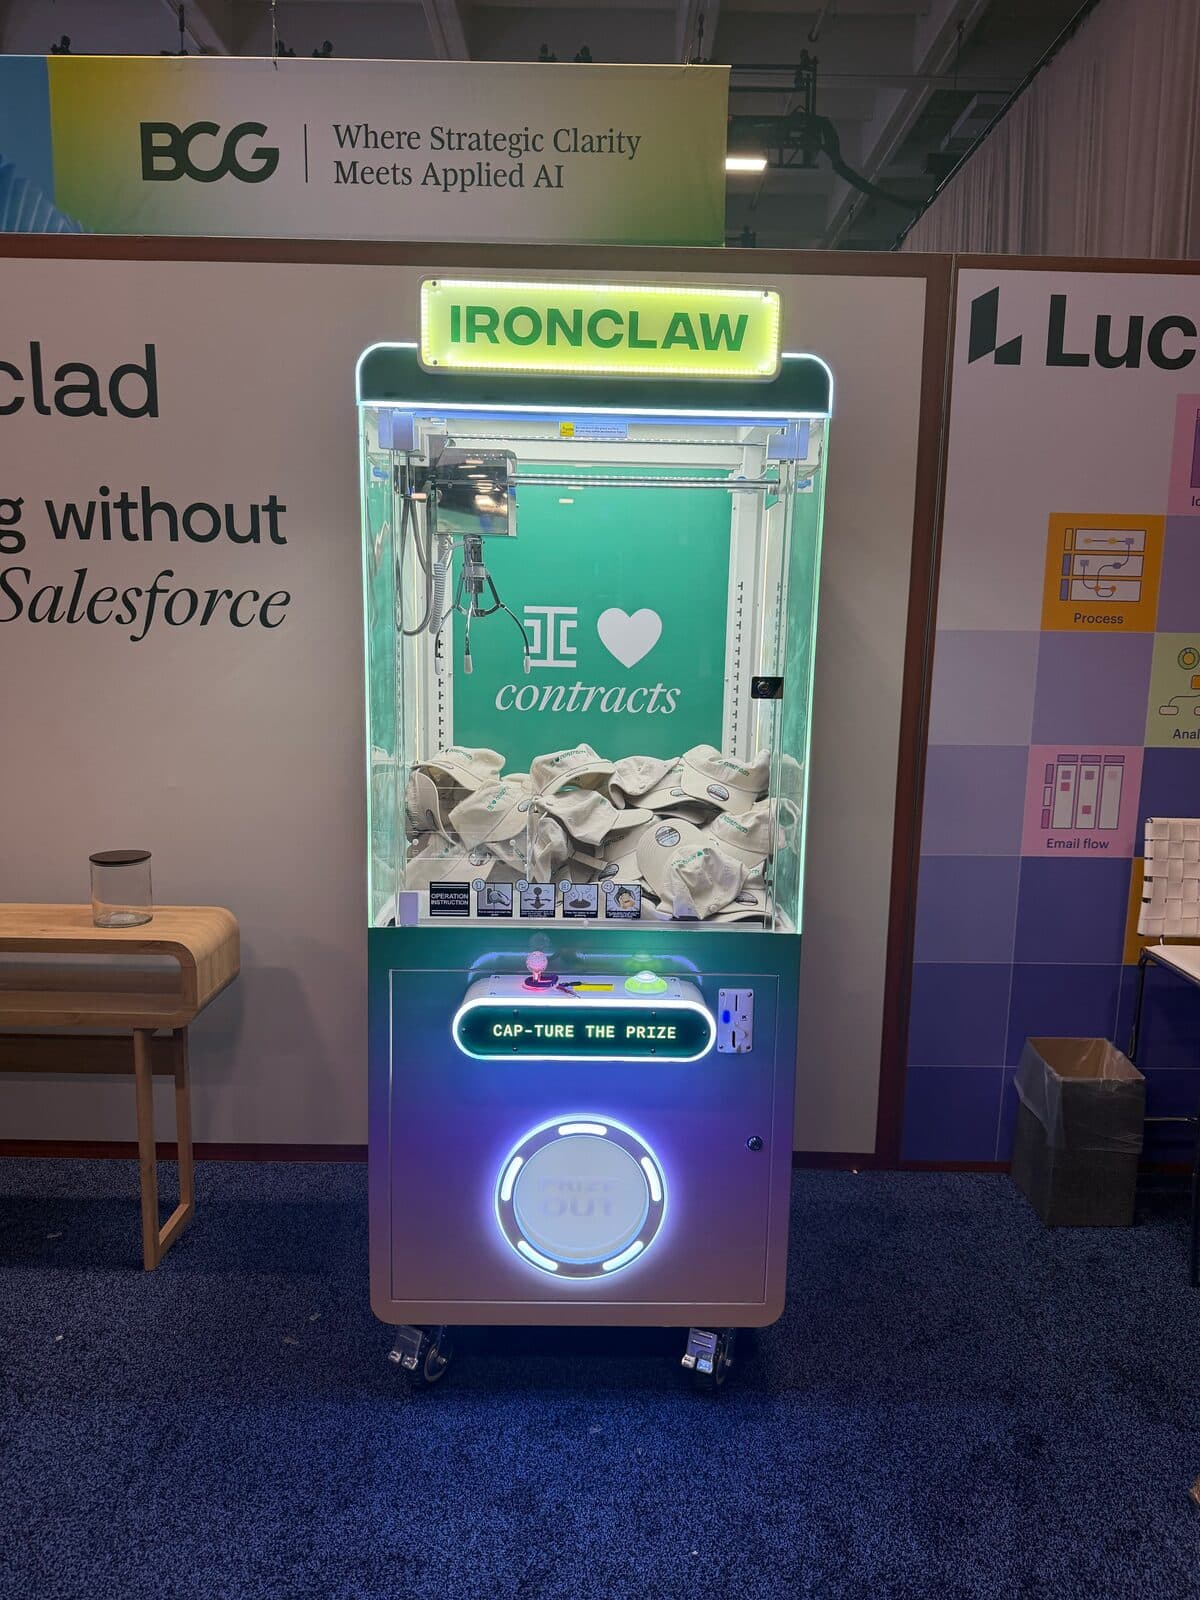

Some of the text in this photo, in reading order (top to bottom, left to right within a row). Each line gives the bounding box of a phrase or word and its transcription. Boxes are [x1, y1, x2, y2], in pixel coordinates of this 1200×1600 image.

[140, 121, 279, 184] BCG
[332, 123, 642, 161] Where Strategic Clarity
[333, 160, 565, 193] Meets Applied AI
[450, 304, 749, 353] IRONCLAW
[1046, 294, 1198, 371] Luc
[44, 485, 288, 545] without
[0, 566, 291, 642] Salesforce
[1073, 612, 1124, 625] Process
[495, 681, 682, 715] contracts
[1172, 728, 1200, 740] Anal
[1046, 837, 1110, 849] Email flow
[492, 1023, 677, 1040] CAP-TURE THE PRIZE
